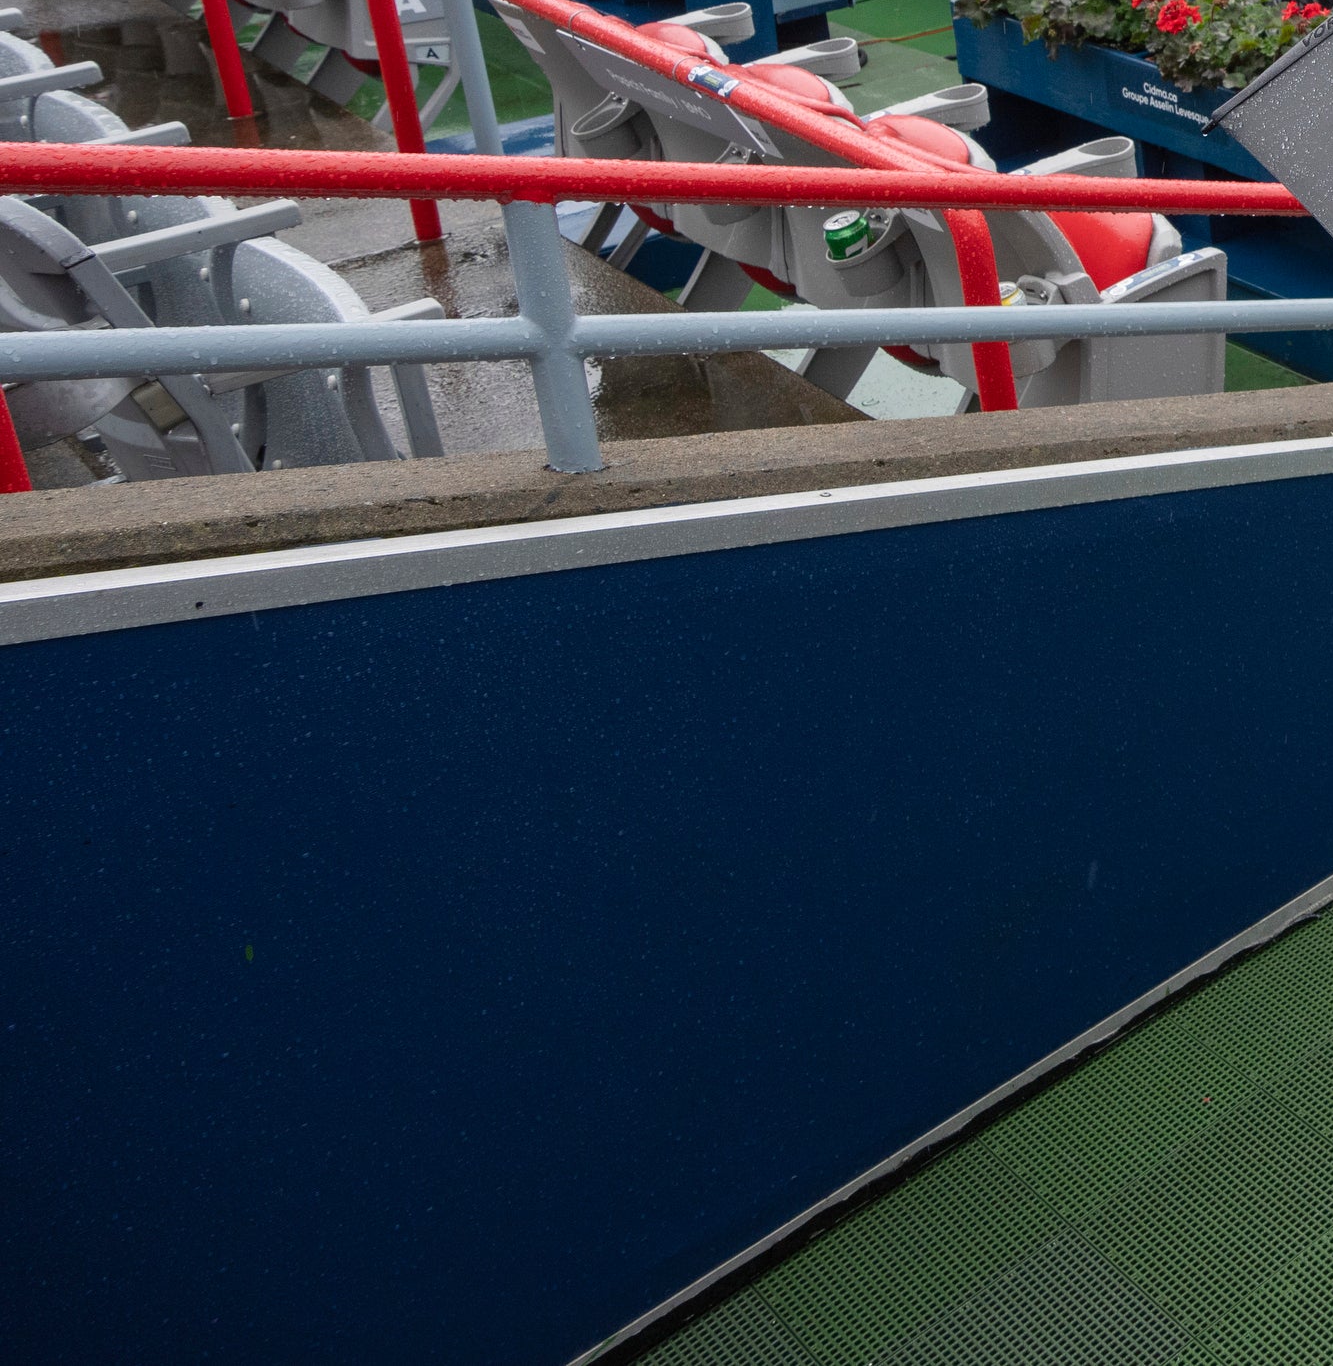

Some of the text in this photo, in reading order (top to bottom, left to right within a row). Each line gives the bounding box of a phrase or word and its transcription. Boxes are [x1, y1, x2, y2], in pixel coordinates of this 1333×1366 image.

[426, 47, 440, 59] A
[1143, 81, 1179, 103] Cidma.ca
[1121, 87, 1211, 125] Groupe Asselin Levesque
